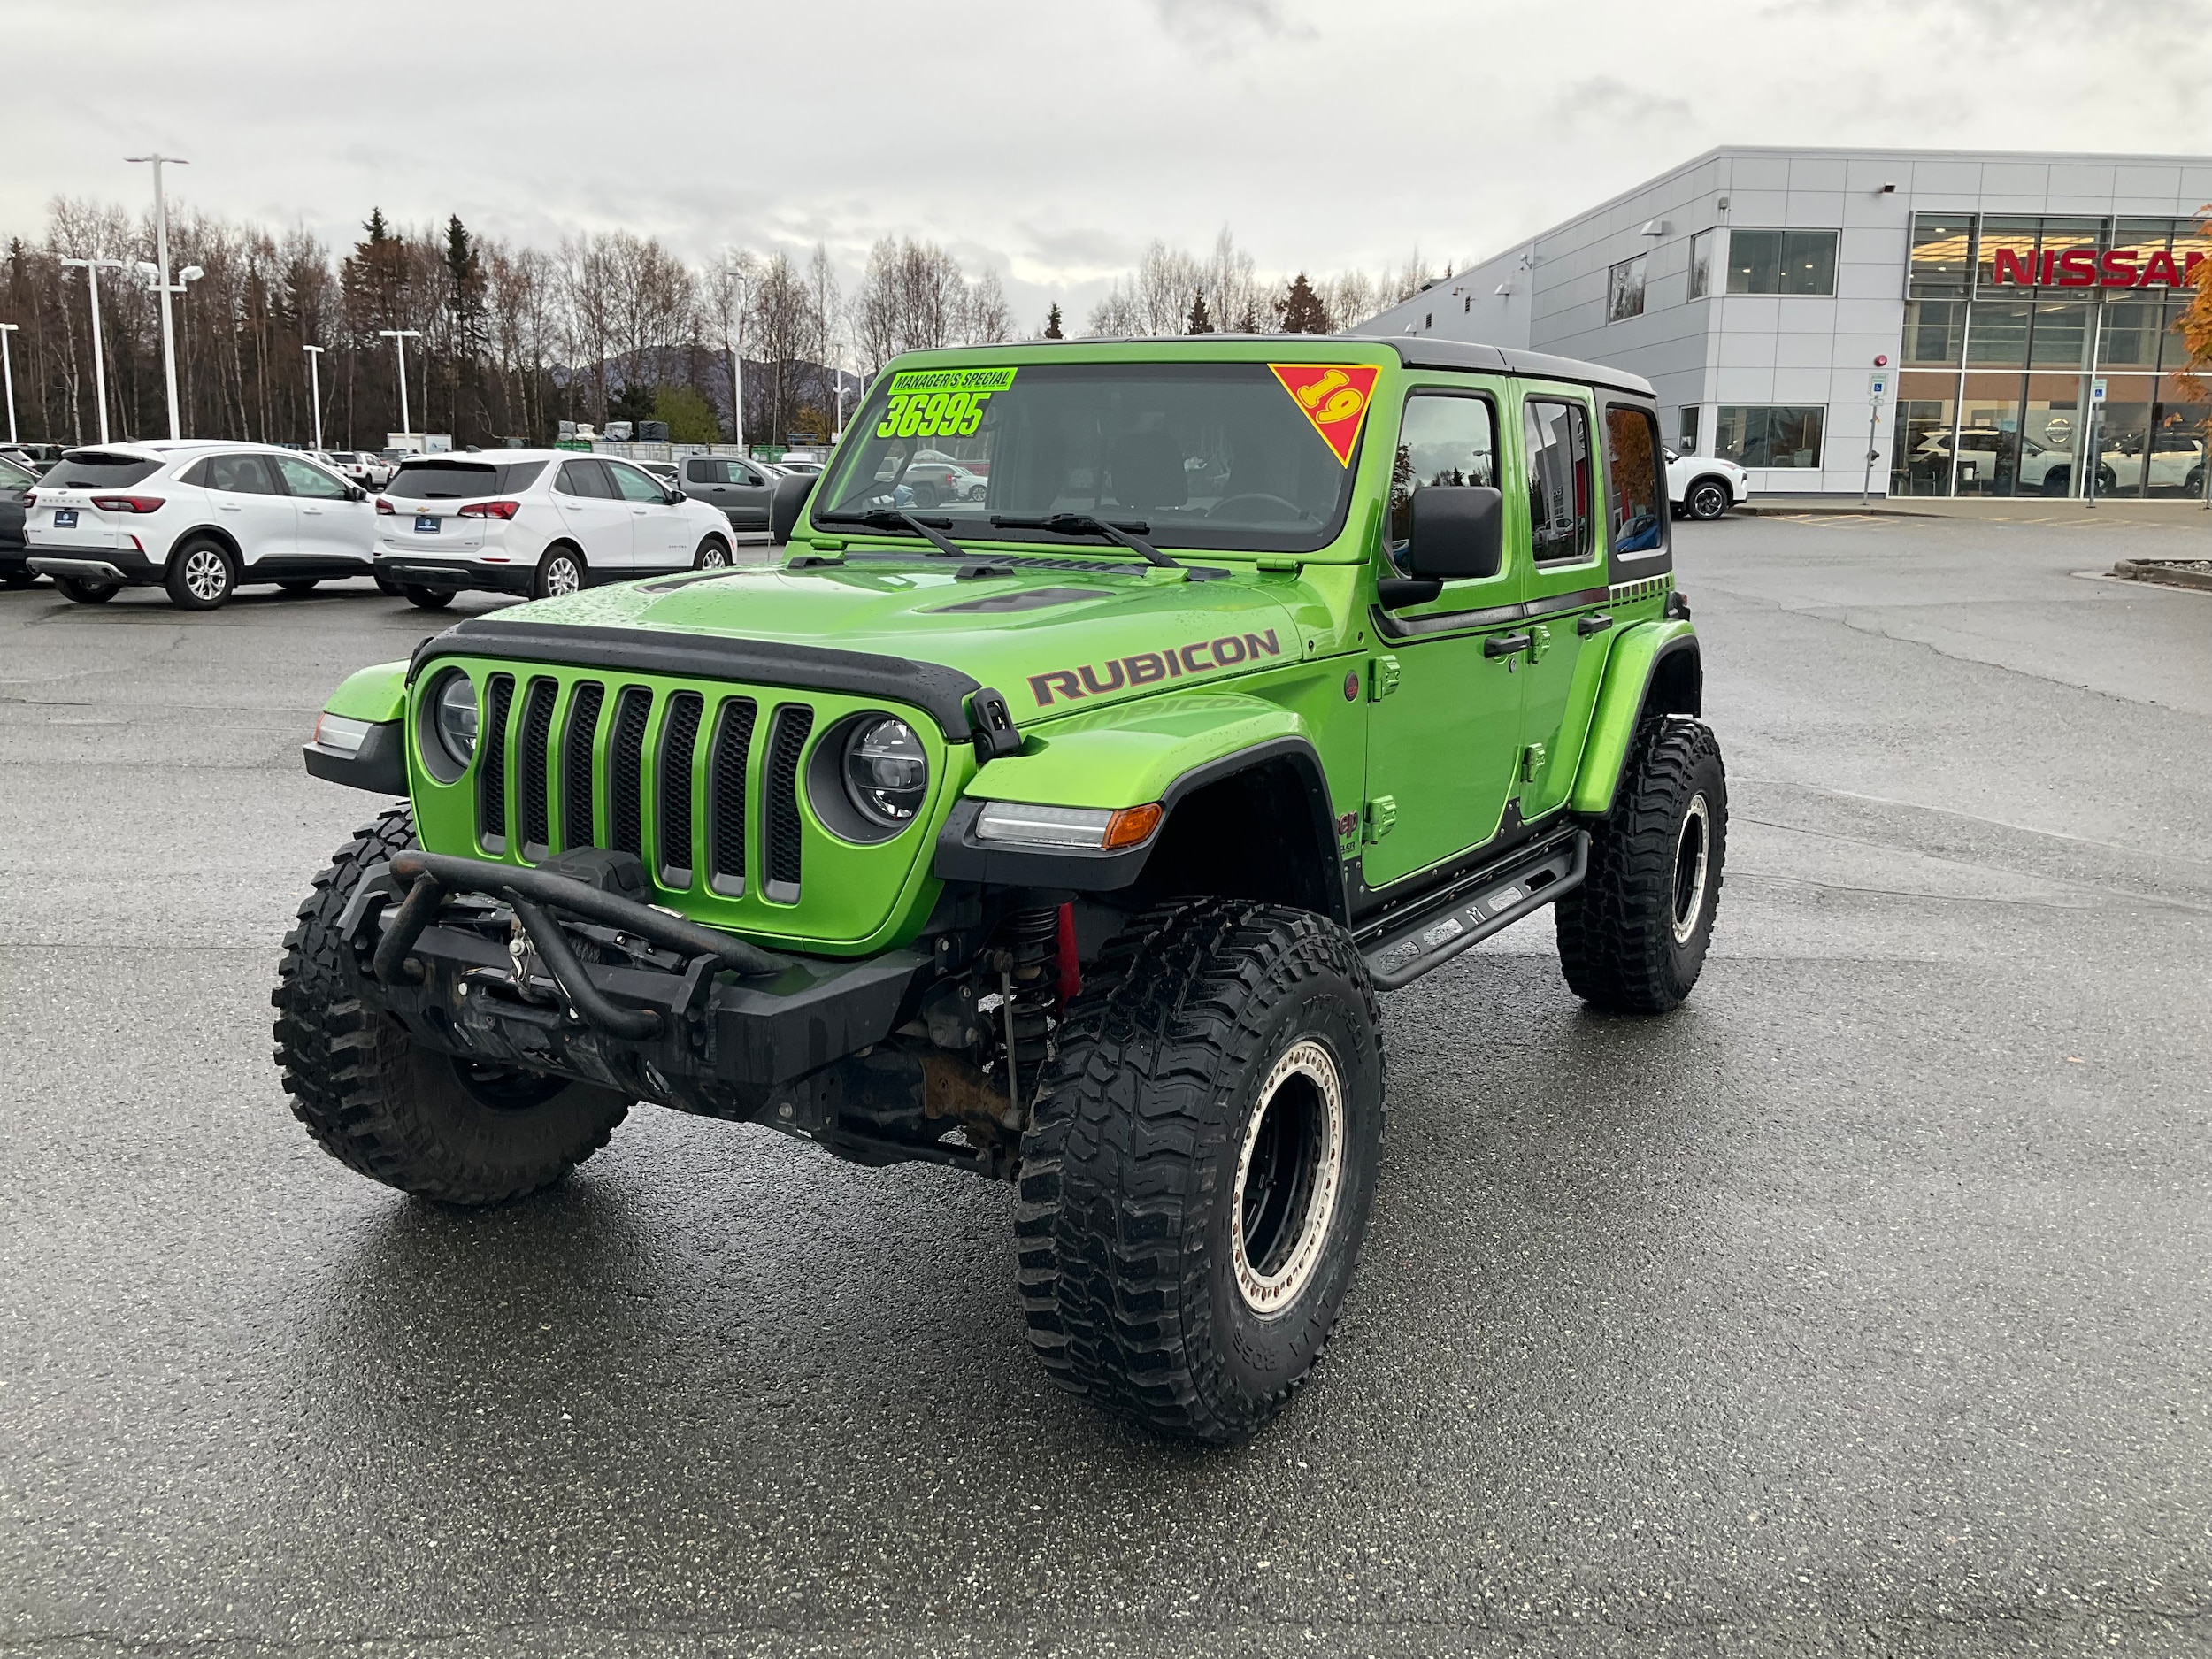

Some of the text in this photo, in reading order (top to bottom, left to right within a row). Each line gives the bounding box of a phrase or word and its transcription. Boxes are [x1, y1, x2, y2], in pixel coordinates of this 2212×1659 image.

[894, 371, 1010, 390] MANAGER'S SPECIAL
[1297, 369, 1363, 424] 19
[876, 392, 991, 438] 36995
[1026, 628, 1281, 707] RUBICON
[1337, 810, 1358, 838] ep
